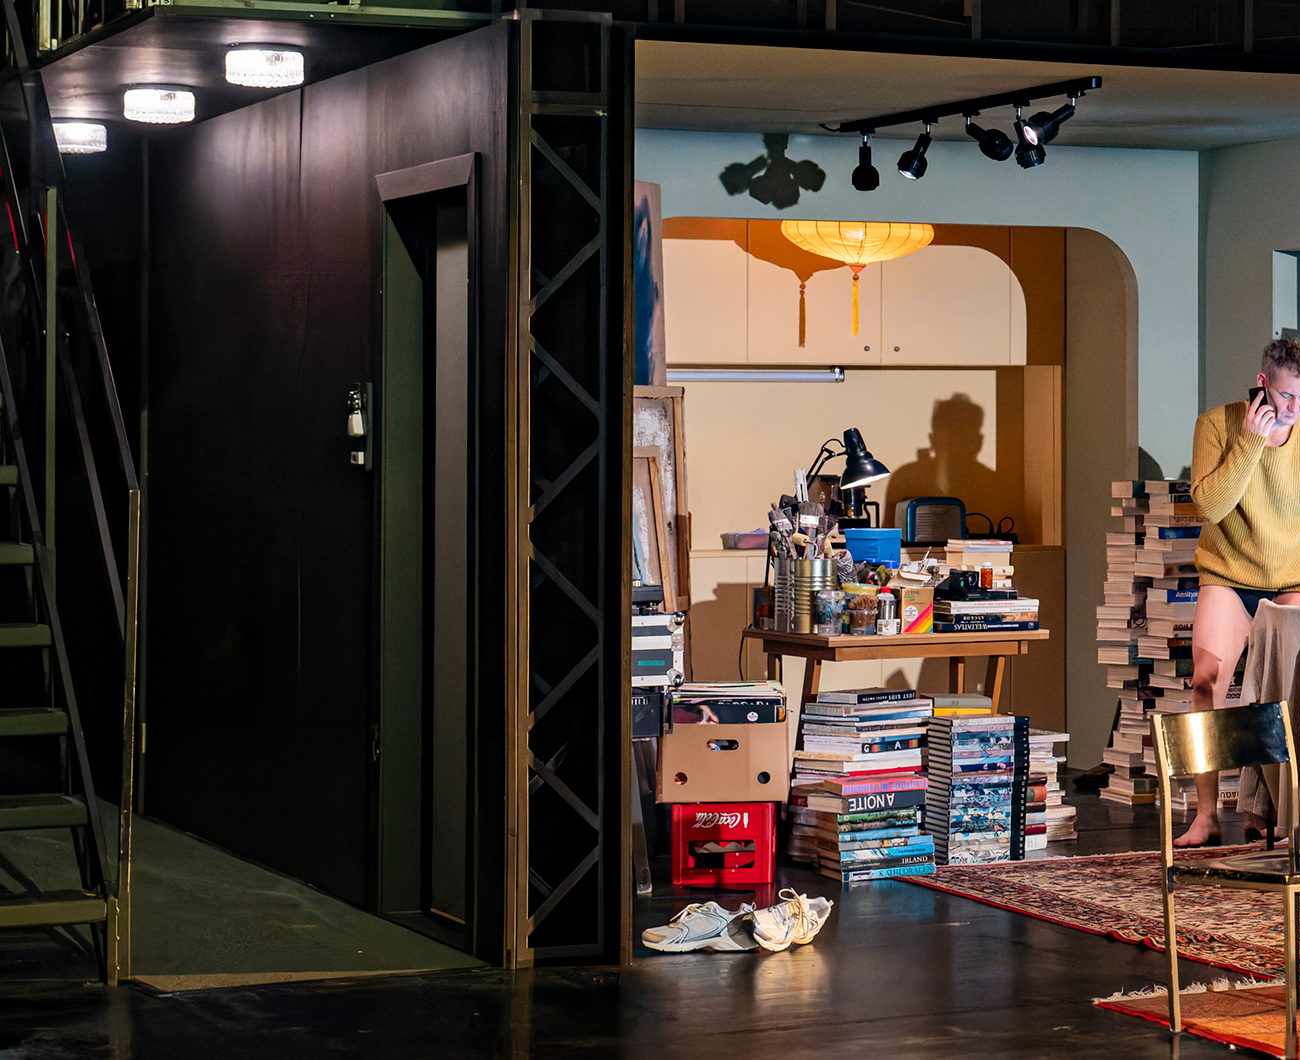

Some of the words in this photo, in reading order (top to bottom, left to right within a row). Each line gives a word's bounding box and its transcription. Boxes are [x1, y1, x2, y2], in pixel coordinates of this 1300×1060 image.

[953, 623, 988, 631] WELTATLAS
[888, 692, 901, 700] KIDS
[903, 690, 915, 700] JUST
[849, 794, 885, 812] NOITE
[887, 793, 895, 805] A
[901, 855, 928, 865] IRLAND
[878, 864, 933, 878] KATHEDRALEN
